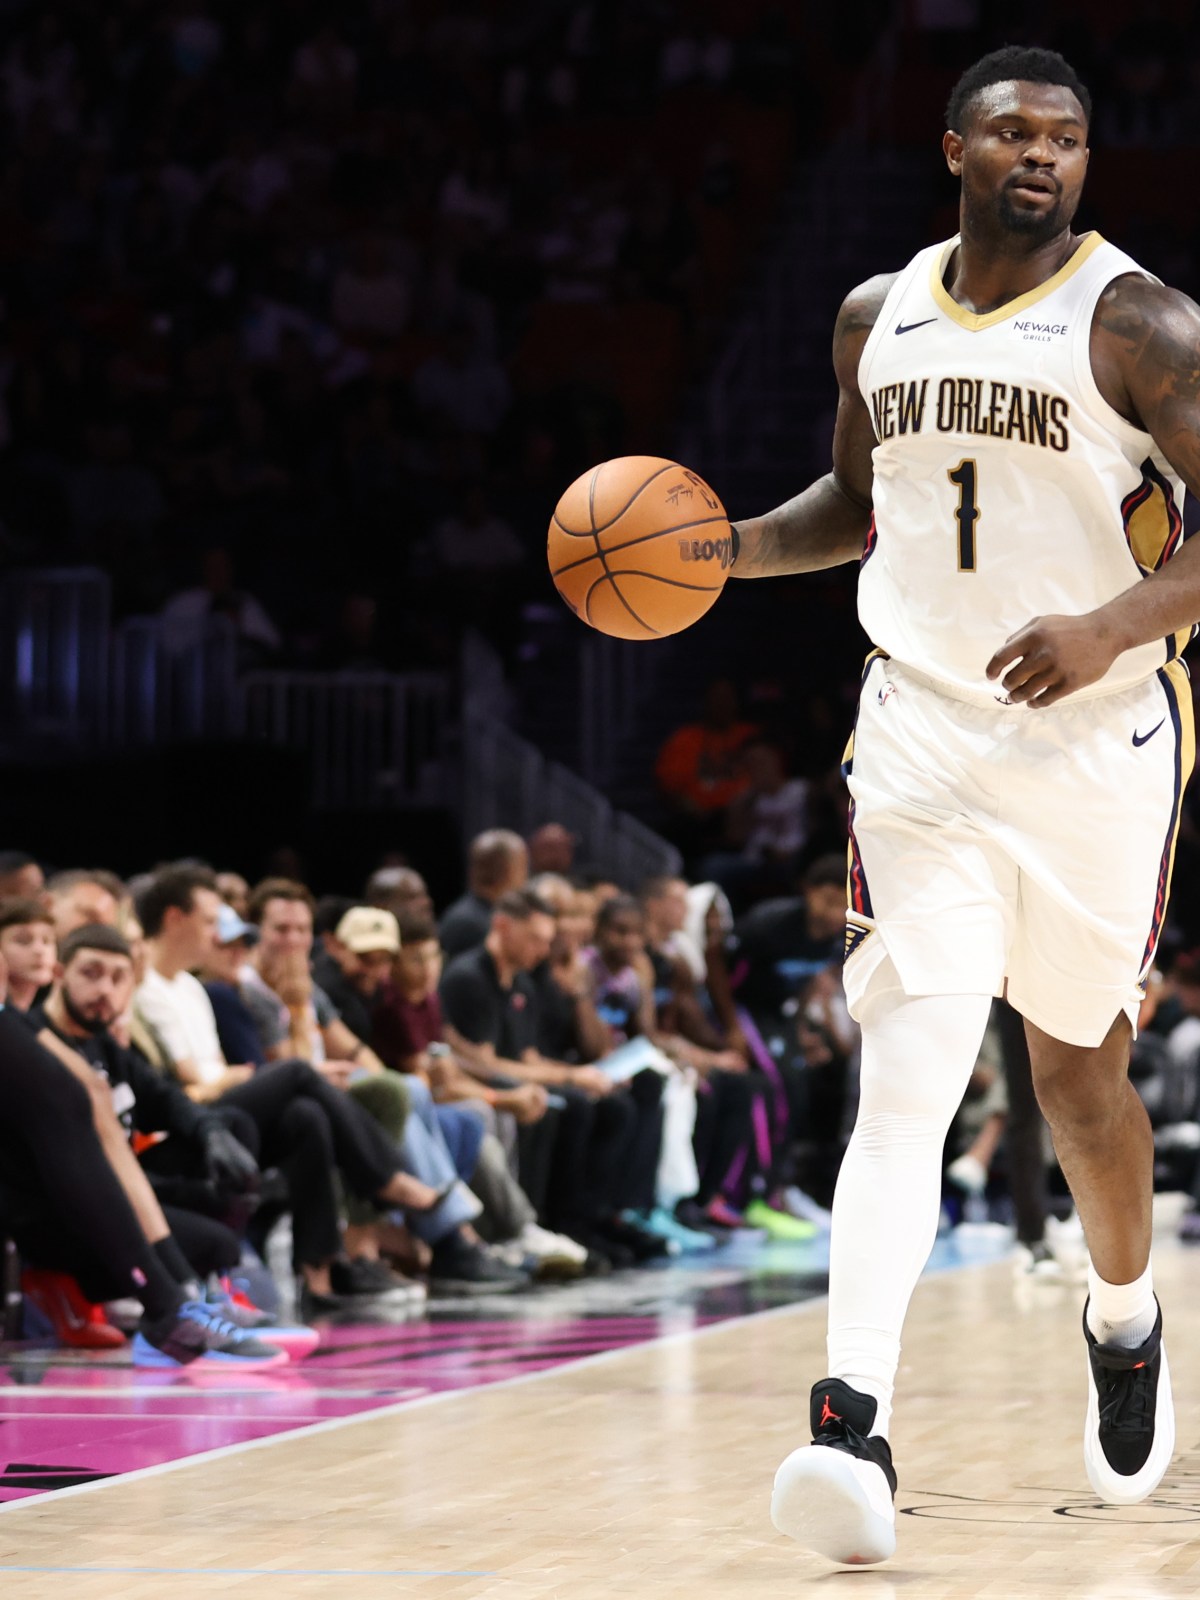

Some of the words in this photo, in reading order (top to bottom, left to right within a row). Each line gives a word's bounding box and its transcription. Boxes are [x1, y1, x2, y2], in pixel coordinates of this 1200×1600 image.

[1013, 321, 1068, 335] NEWAGE
[1023, 334, 1051, 342] GRILLS
[871, 377, 930, 445] NEW
[936, 377, 1069, 452] ORLEANS
[947, 458, 981, 573] 1
